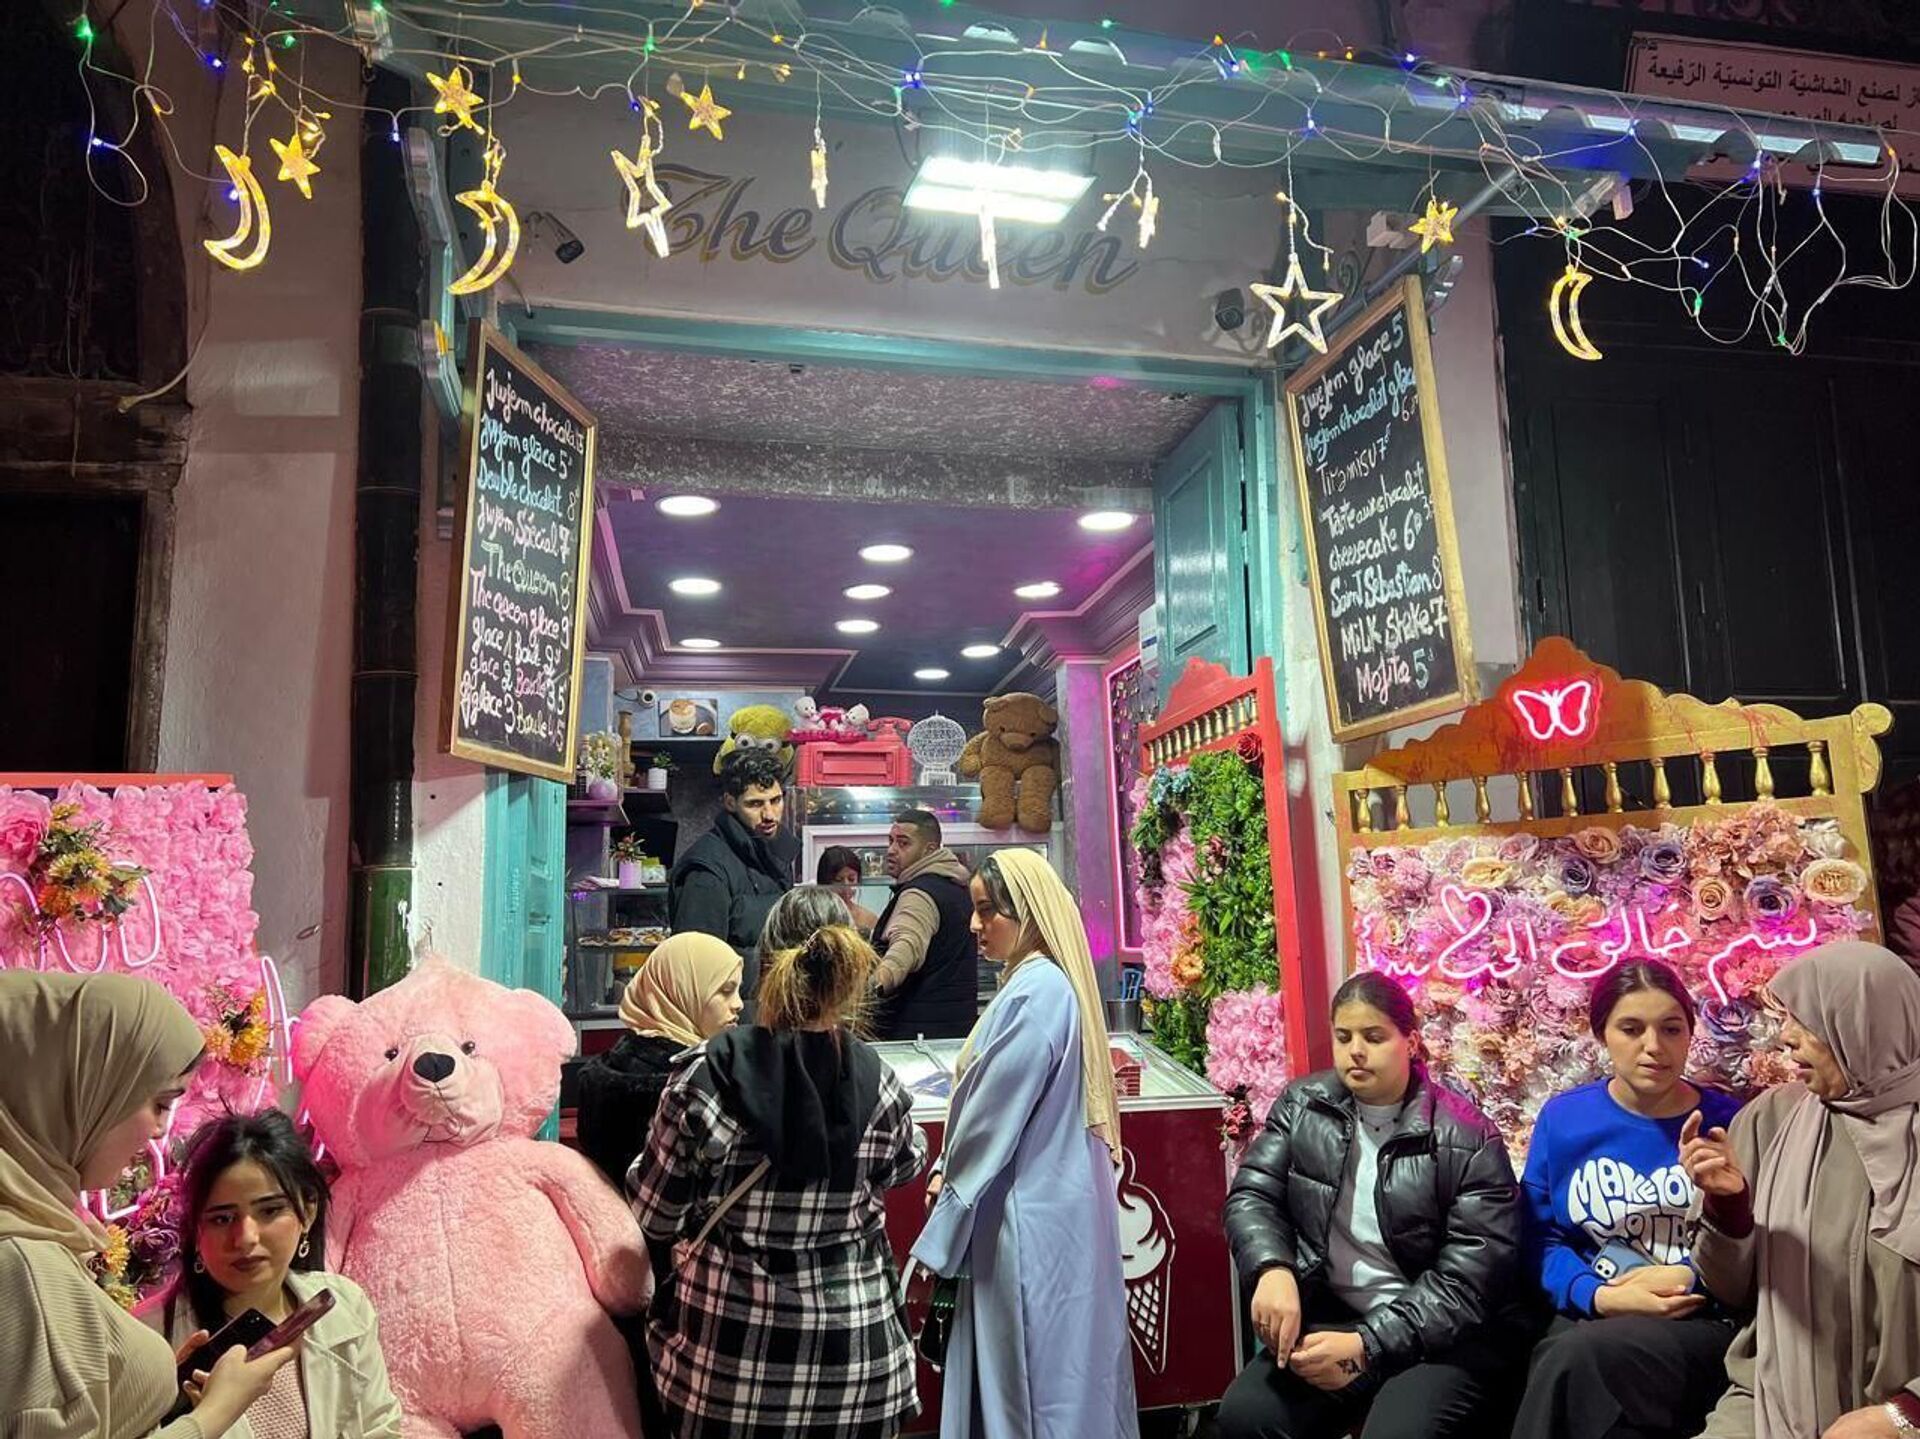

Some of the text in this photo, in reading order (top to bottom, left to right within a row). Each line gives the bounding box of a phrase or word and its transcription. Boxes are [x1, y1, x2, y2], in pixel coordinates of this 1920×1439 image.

[618, 163, 1140, 294] The Queen
[1568, 1157, 1659, 1226] MAKE
